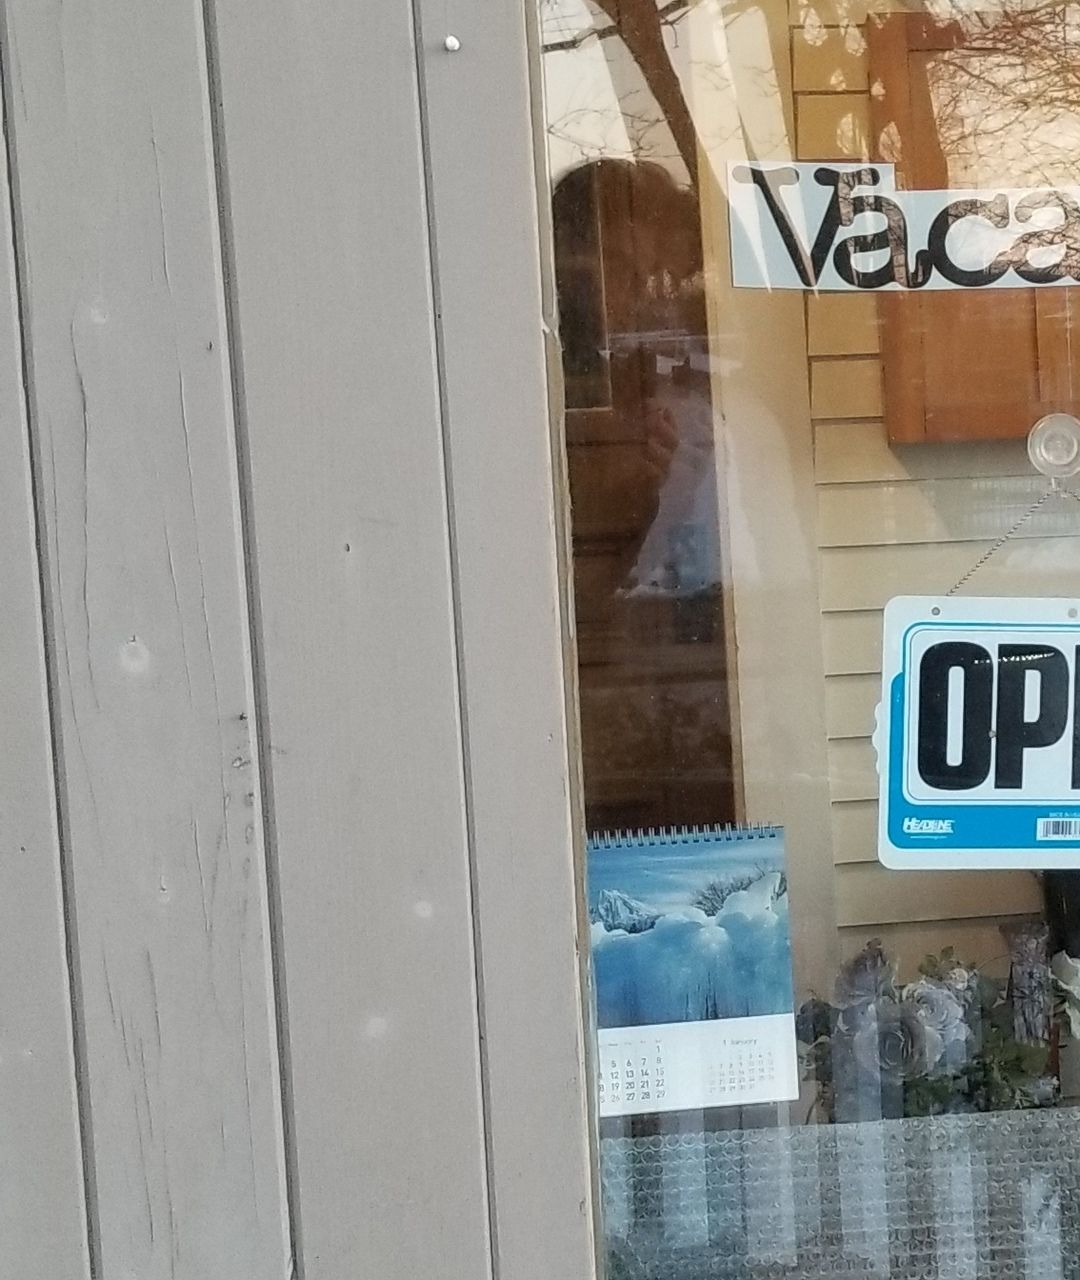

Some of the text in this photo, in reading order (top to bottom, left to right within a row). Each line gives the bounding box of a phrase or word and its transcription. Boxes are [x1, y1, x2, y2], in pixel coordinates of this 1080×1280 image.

[611, 1060, 617, 1068] 5
[626, 1059, 632, 1067] 6
[641, 1057, 647, 1066] 7
[610, 1071, 620, 1080] 12
[640, 1069, 649, 1077] 14
[611, 1082, 620, 1091] 19
[625, 1081, 635, 1090] 20
[640, 1080, 649, 1089] 21
[655, 1079, 665, 1088] 22
[625, 1092, 635, 1101] 27
